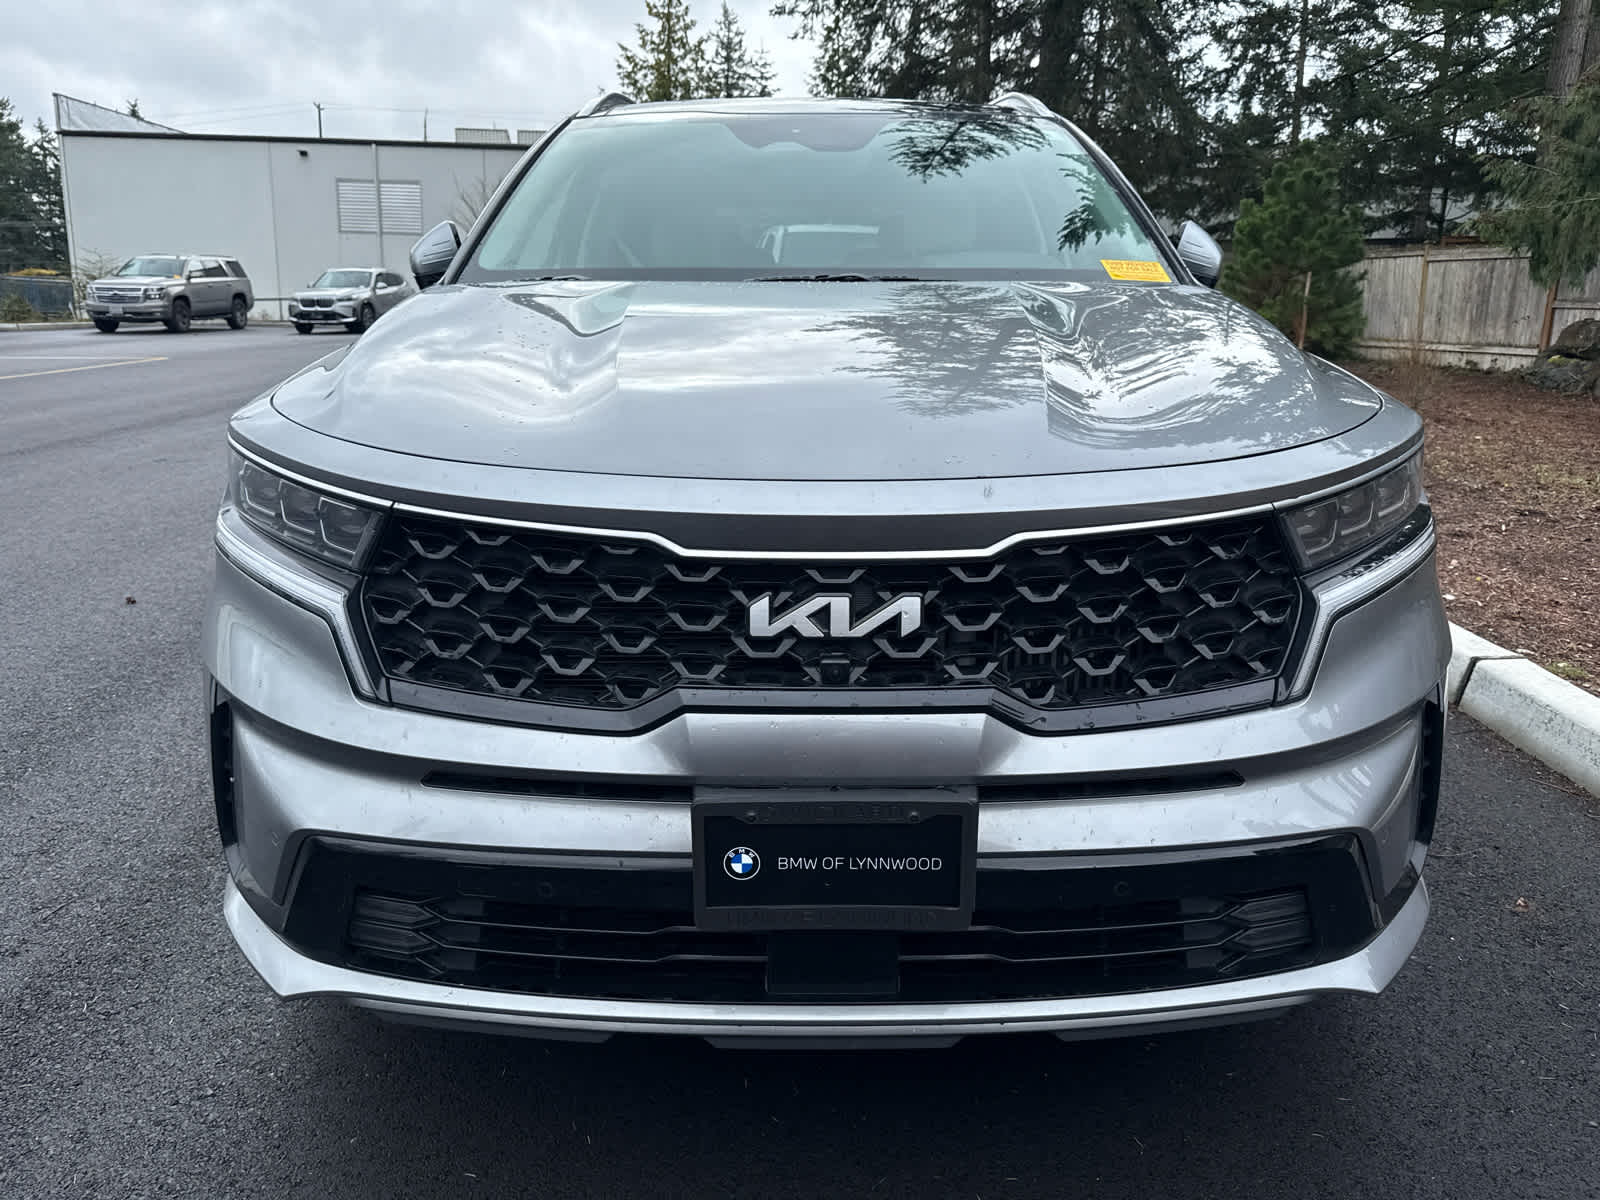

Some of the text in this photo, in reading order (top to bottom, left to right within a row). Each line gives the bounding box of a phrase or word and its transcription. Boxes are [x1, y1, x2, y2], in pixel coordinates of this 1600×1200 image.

[748, 593, 922, 638] KIA
[777, 856, 943, 871] BMW OF LYNNWOOD
